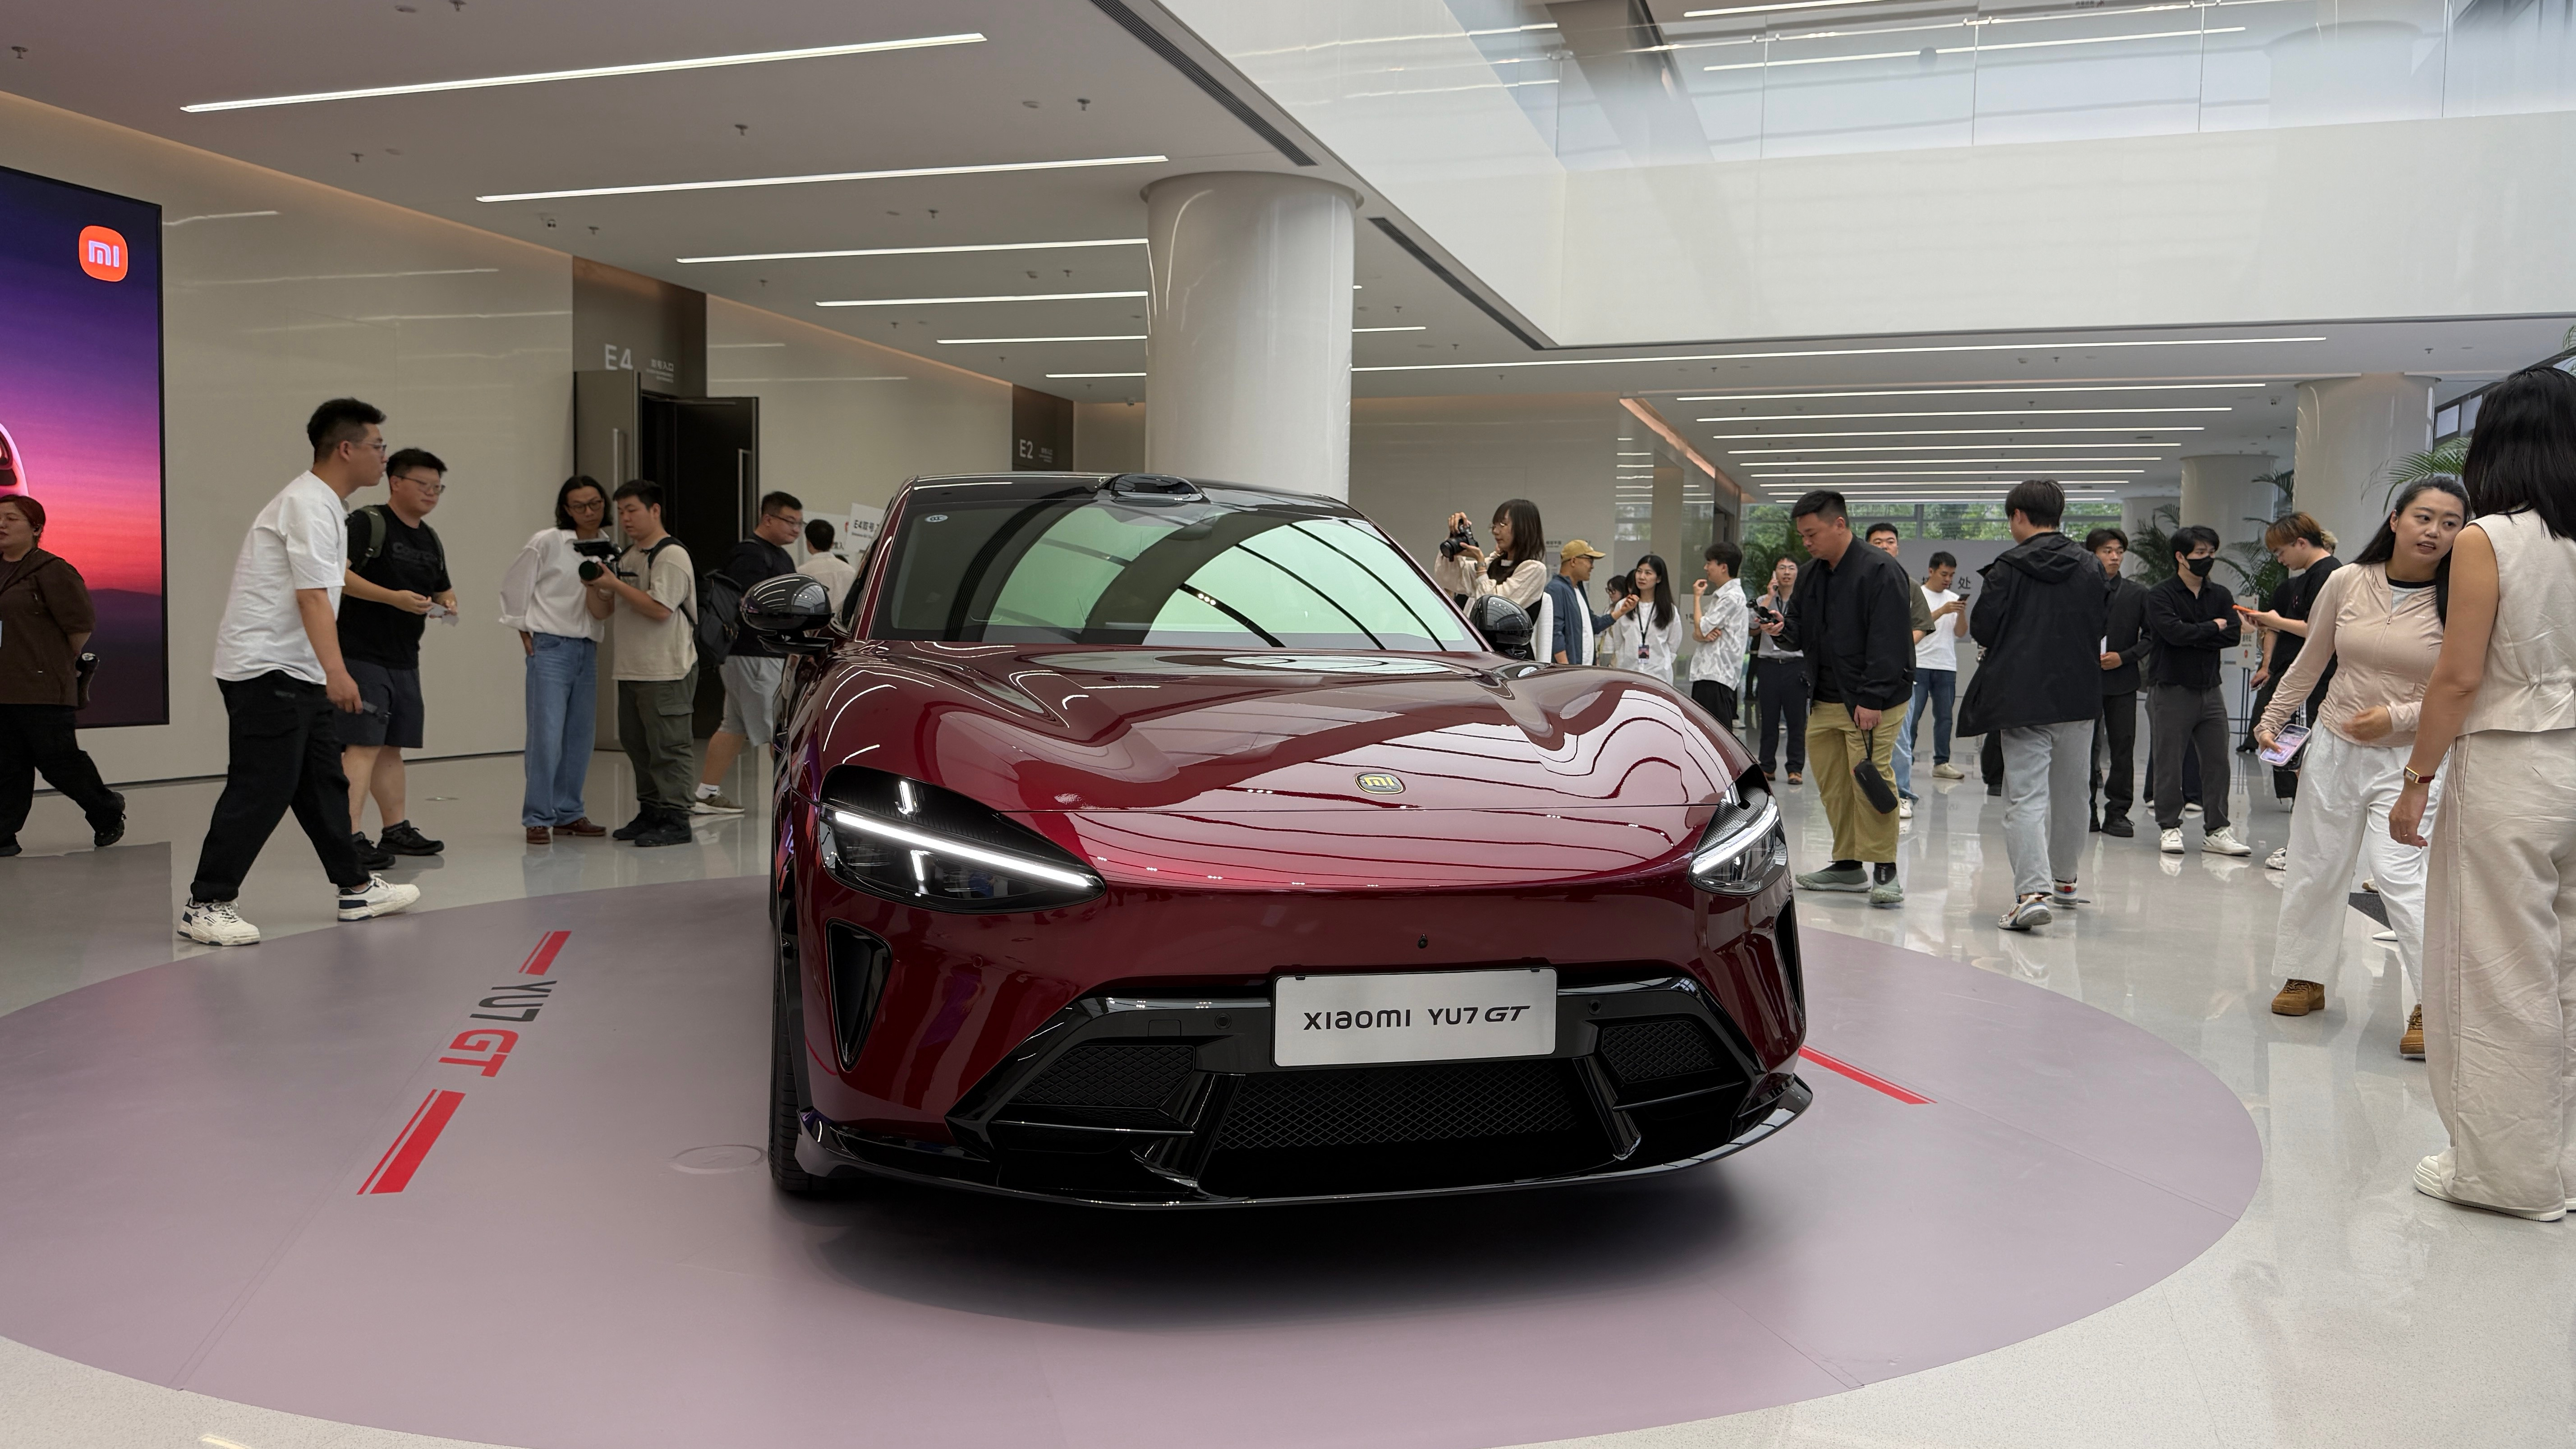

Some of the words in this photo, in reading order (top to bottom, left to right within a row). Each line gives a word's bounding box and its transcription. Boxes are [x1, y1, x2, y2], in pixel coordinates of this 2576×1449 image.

[605, 344, 634, 371] E4
[1020, 439, 1033, 459] E2
[469, 980, 557, 1021] YU7
[1428, 1007, 1478, 1026] YU7
[1485, 1005, 1531, 1022] GT
[438, 1029, 519, 1077] GT
